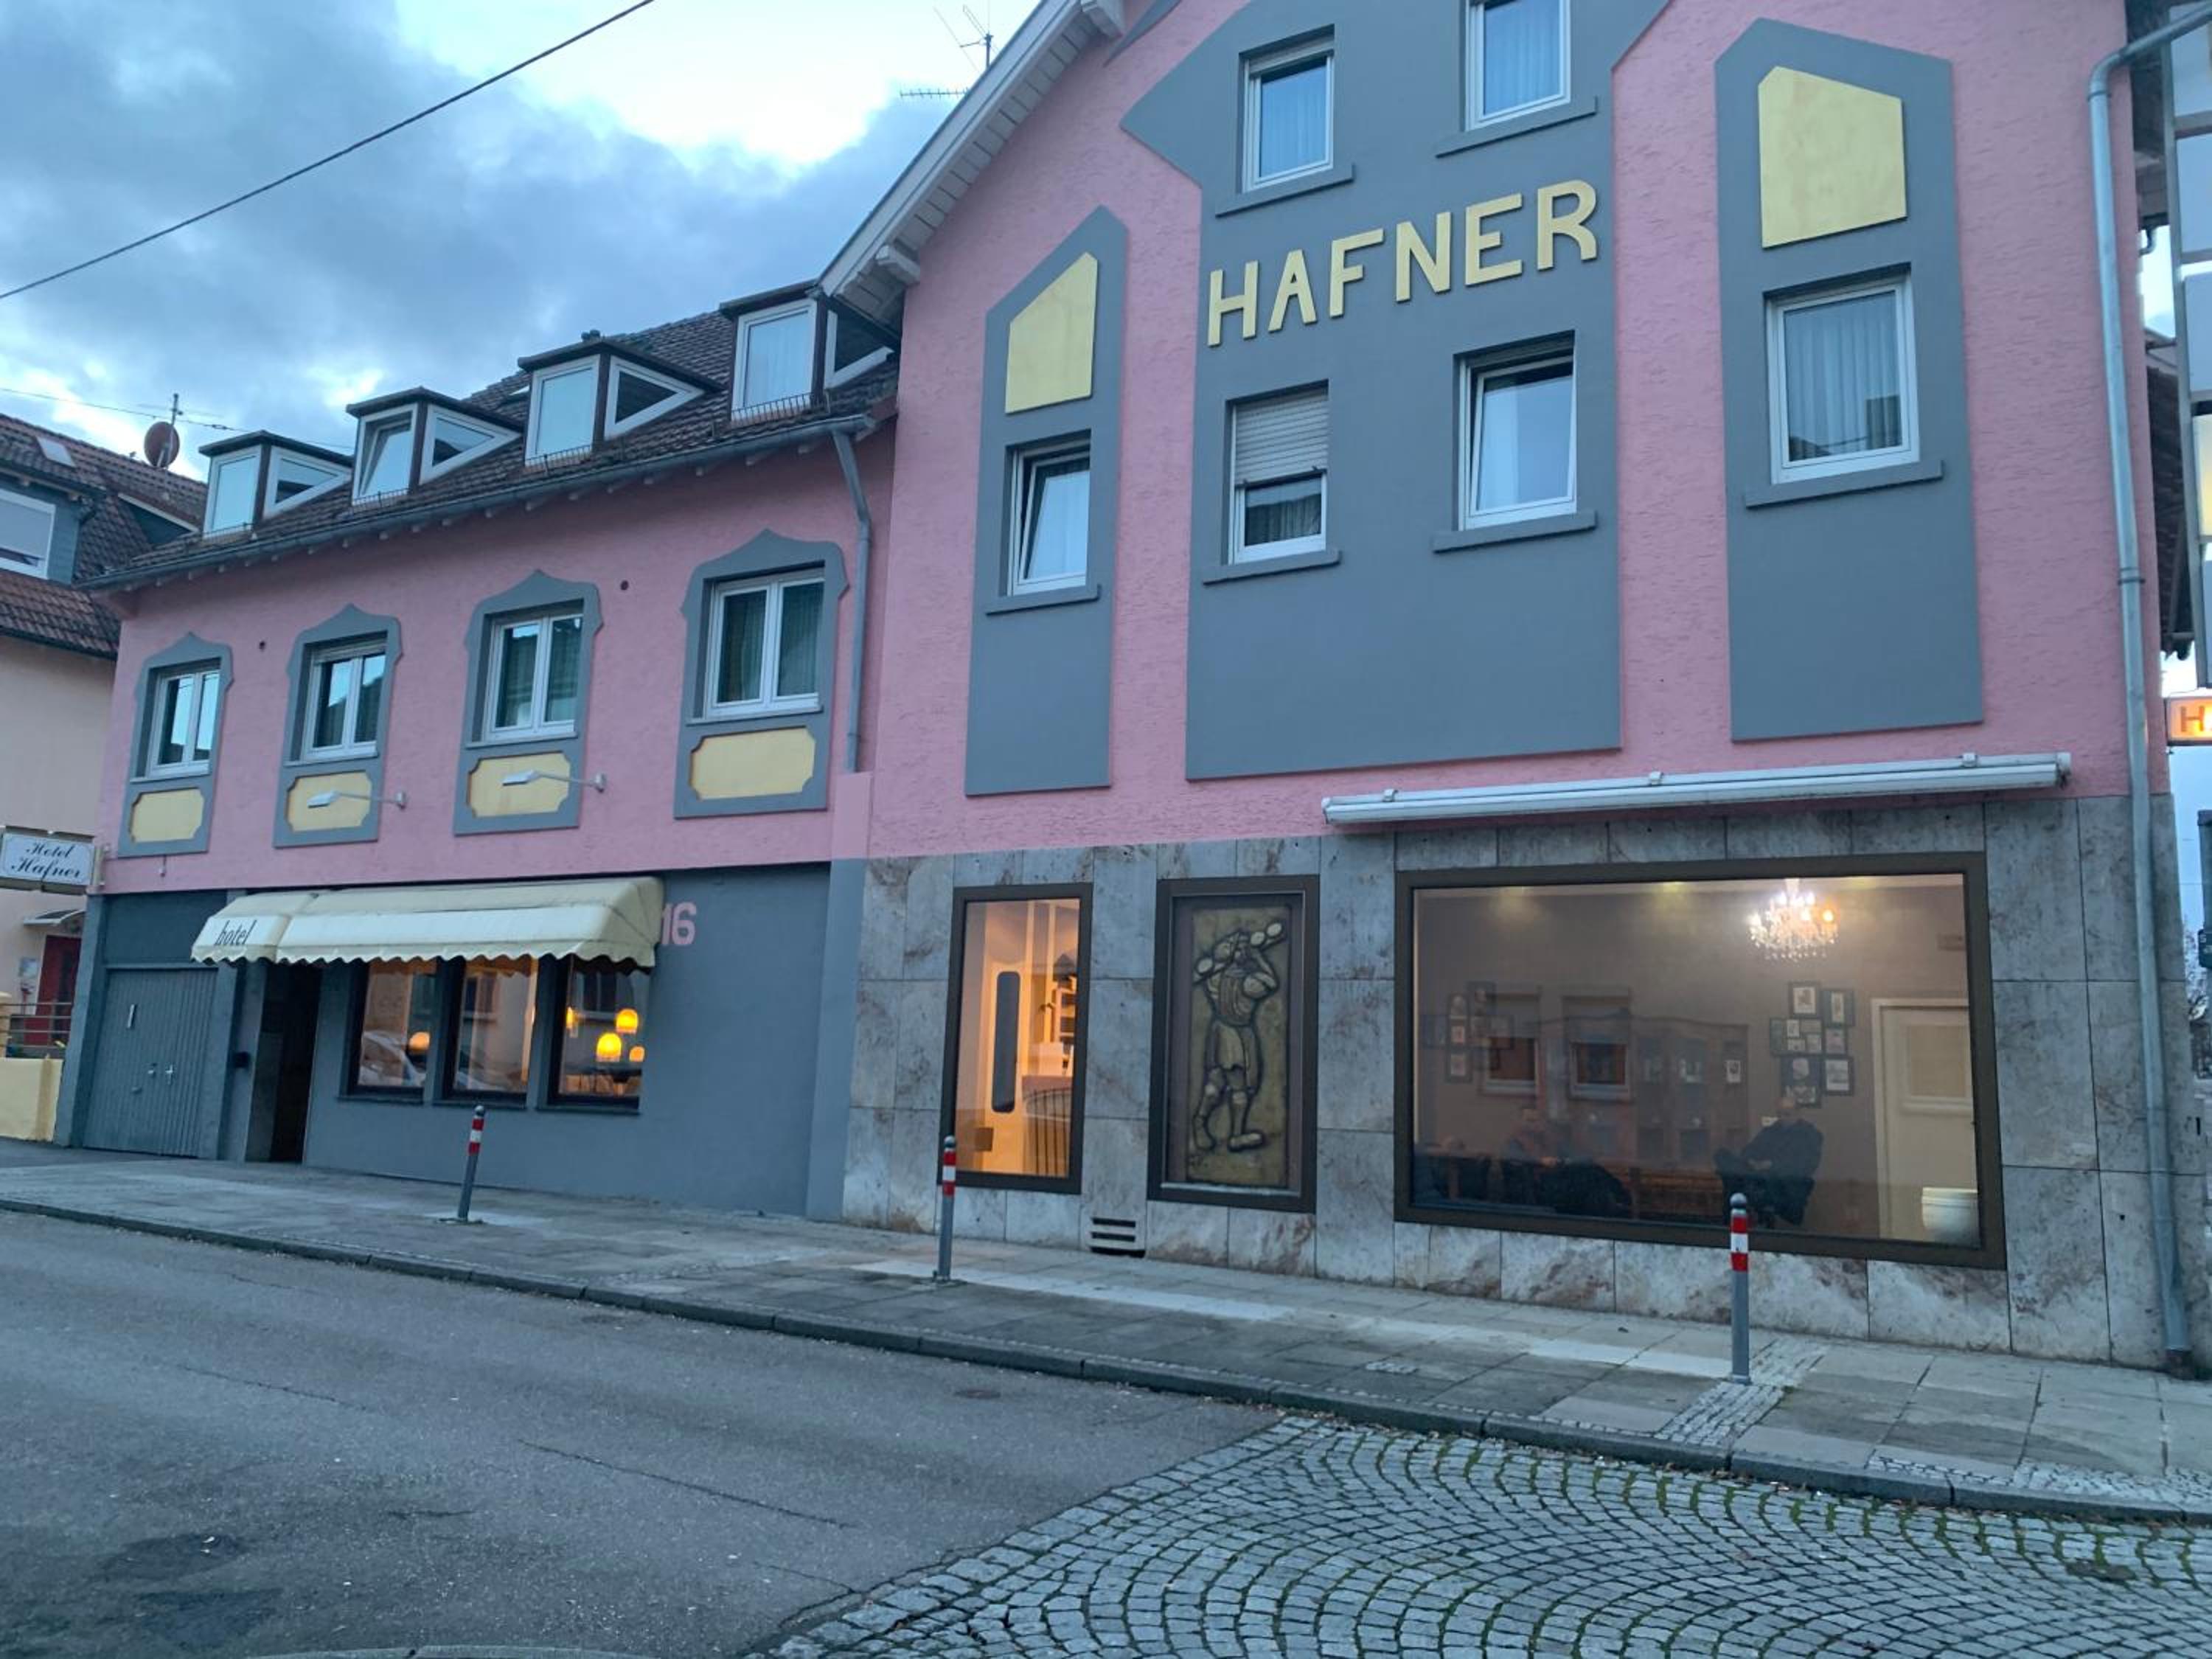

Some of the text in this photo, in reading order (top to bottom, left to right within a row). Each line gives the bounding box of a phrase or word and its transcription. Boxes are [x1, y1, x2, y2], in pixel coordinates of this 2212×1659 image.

[1208, 180, 1598, 347] HAFNER
[2180, 705, 2211, 732] H
[27, 843, 75, 857] Hotel
[12, 857, 80, 879] Hafner
[215, 919, 257, 945] hotel
[661, 902, 697, 945] 16
